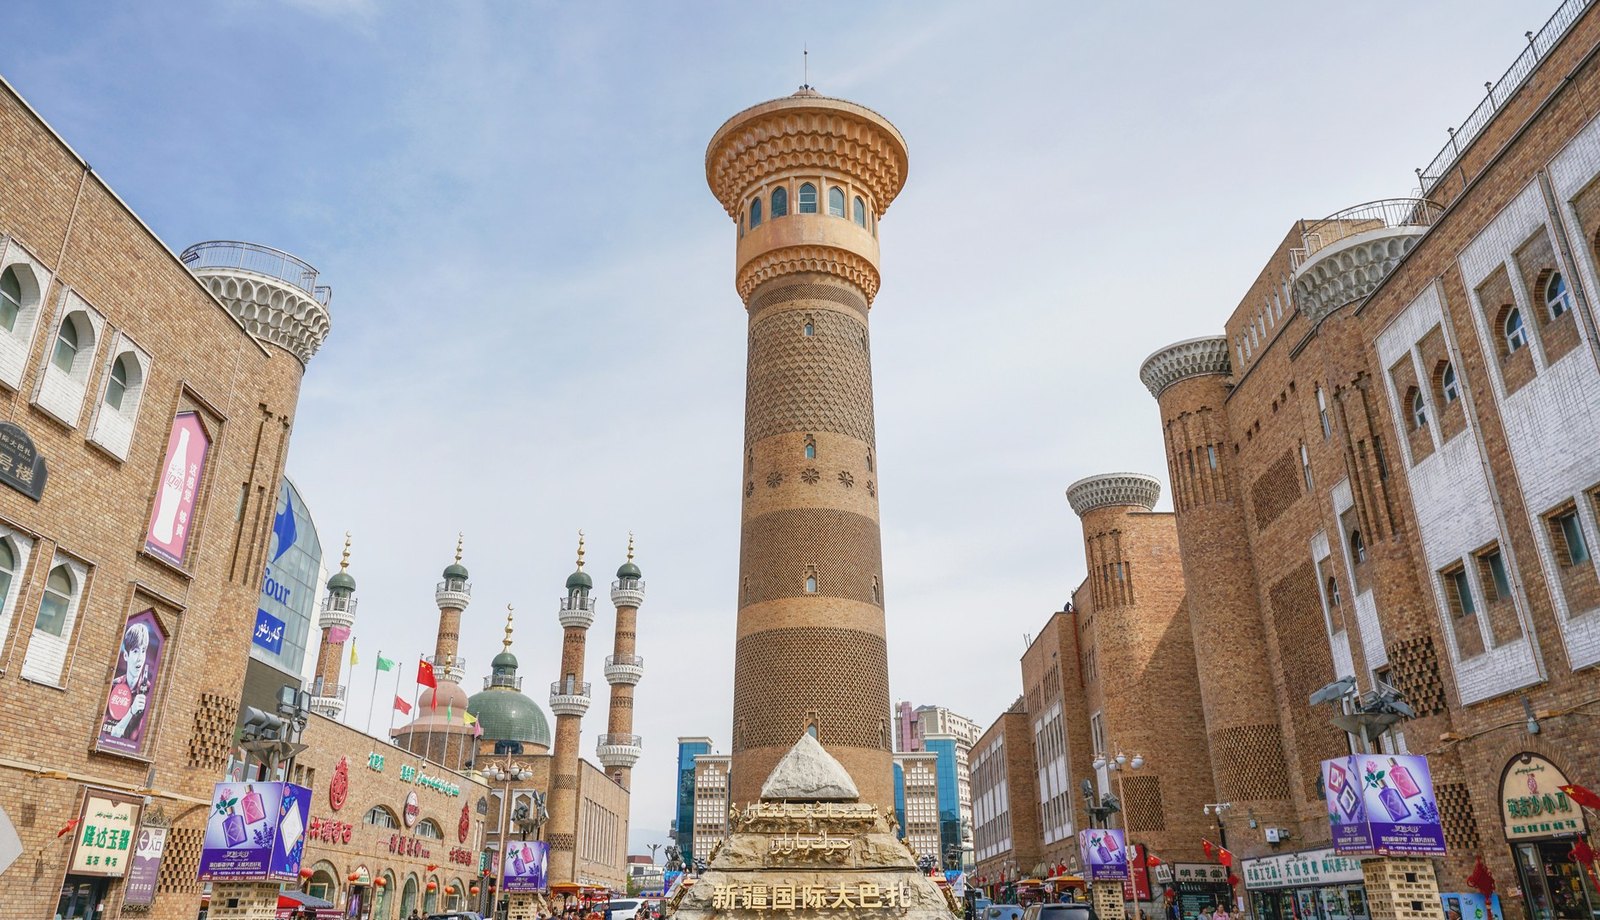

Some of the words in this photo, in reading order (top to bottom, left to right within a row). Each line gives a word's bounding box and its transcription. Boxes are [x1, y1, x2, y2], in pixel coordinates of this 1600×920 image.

[0, 432, 31, 456] 际大巴扎
[81, 825, 131, 850] 隆达玉器
[148, 840, 162, 851] 入口
[712, 881, 912, 910] 新疆国际大巴扎
